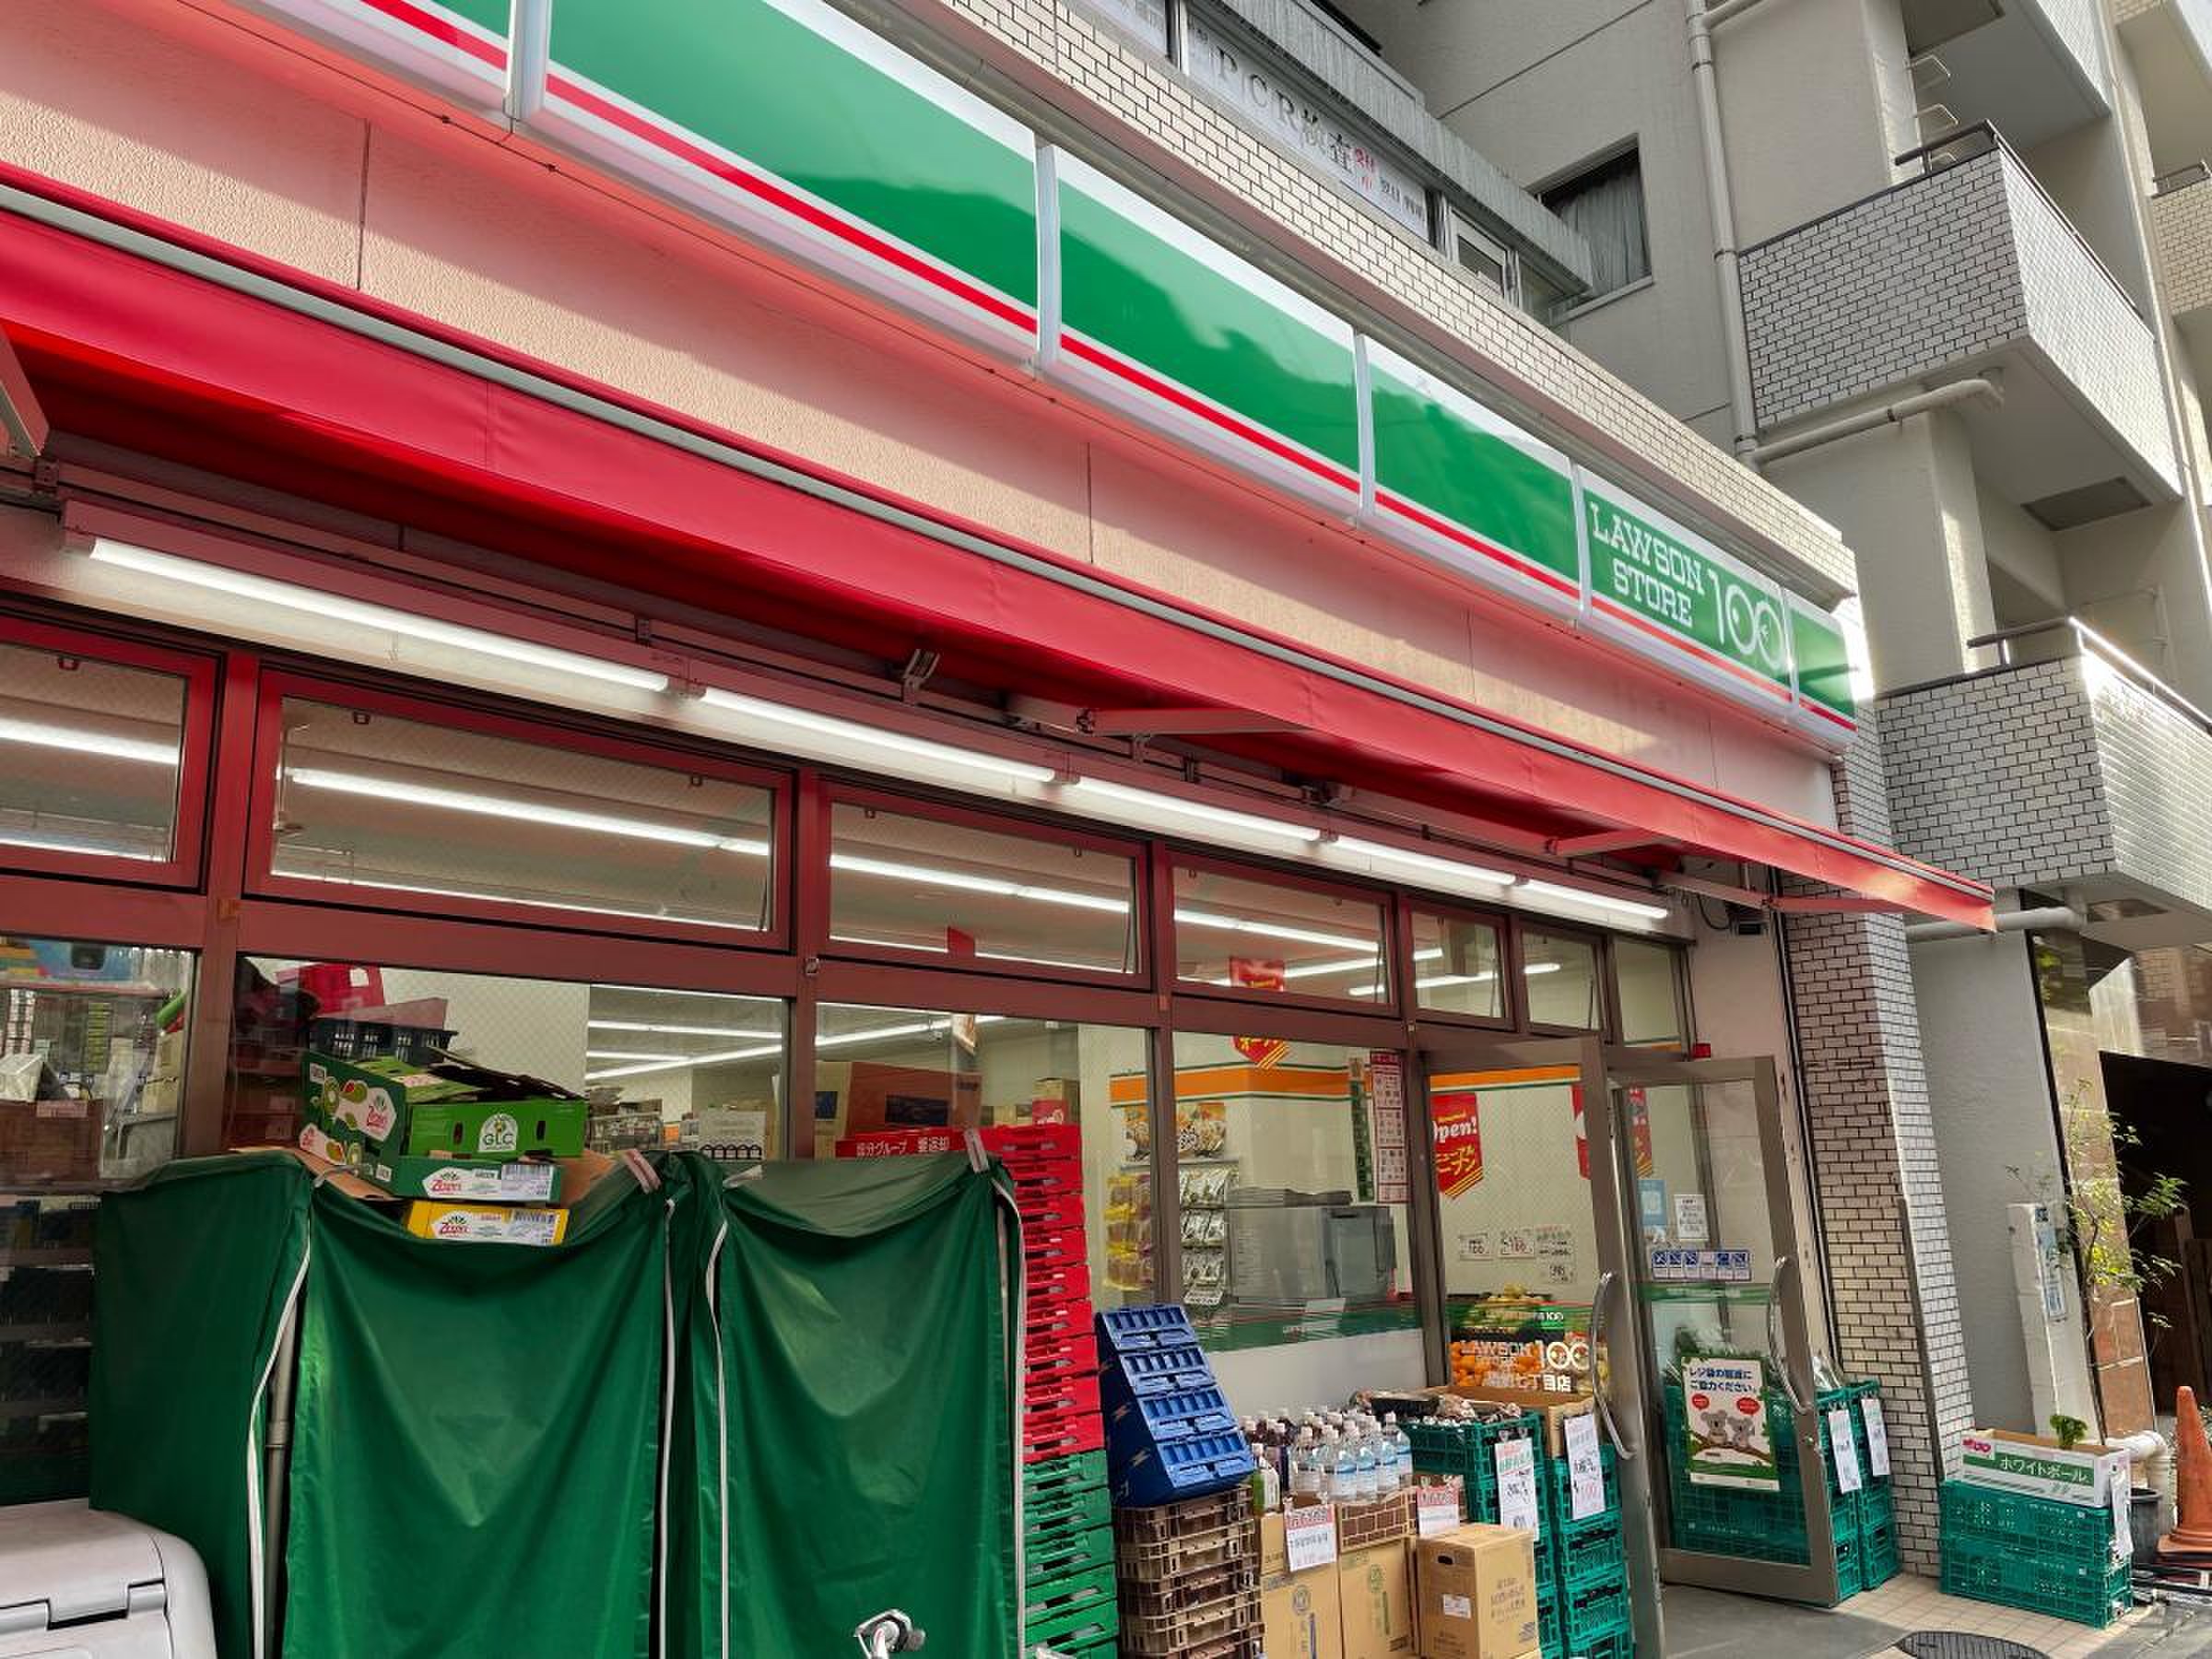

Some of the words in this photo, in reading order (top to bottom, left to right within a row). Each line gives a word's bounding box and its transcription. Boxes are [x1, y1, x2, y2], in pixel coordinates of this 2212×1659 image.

[1590, 501, 1705, 594] LAWSON
[1613, 558, 1693, 629] STORE
[1709, 568, 1786, 670] 100
[1999, 1457, 2088, 1482] ホワイトボール
